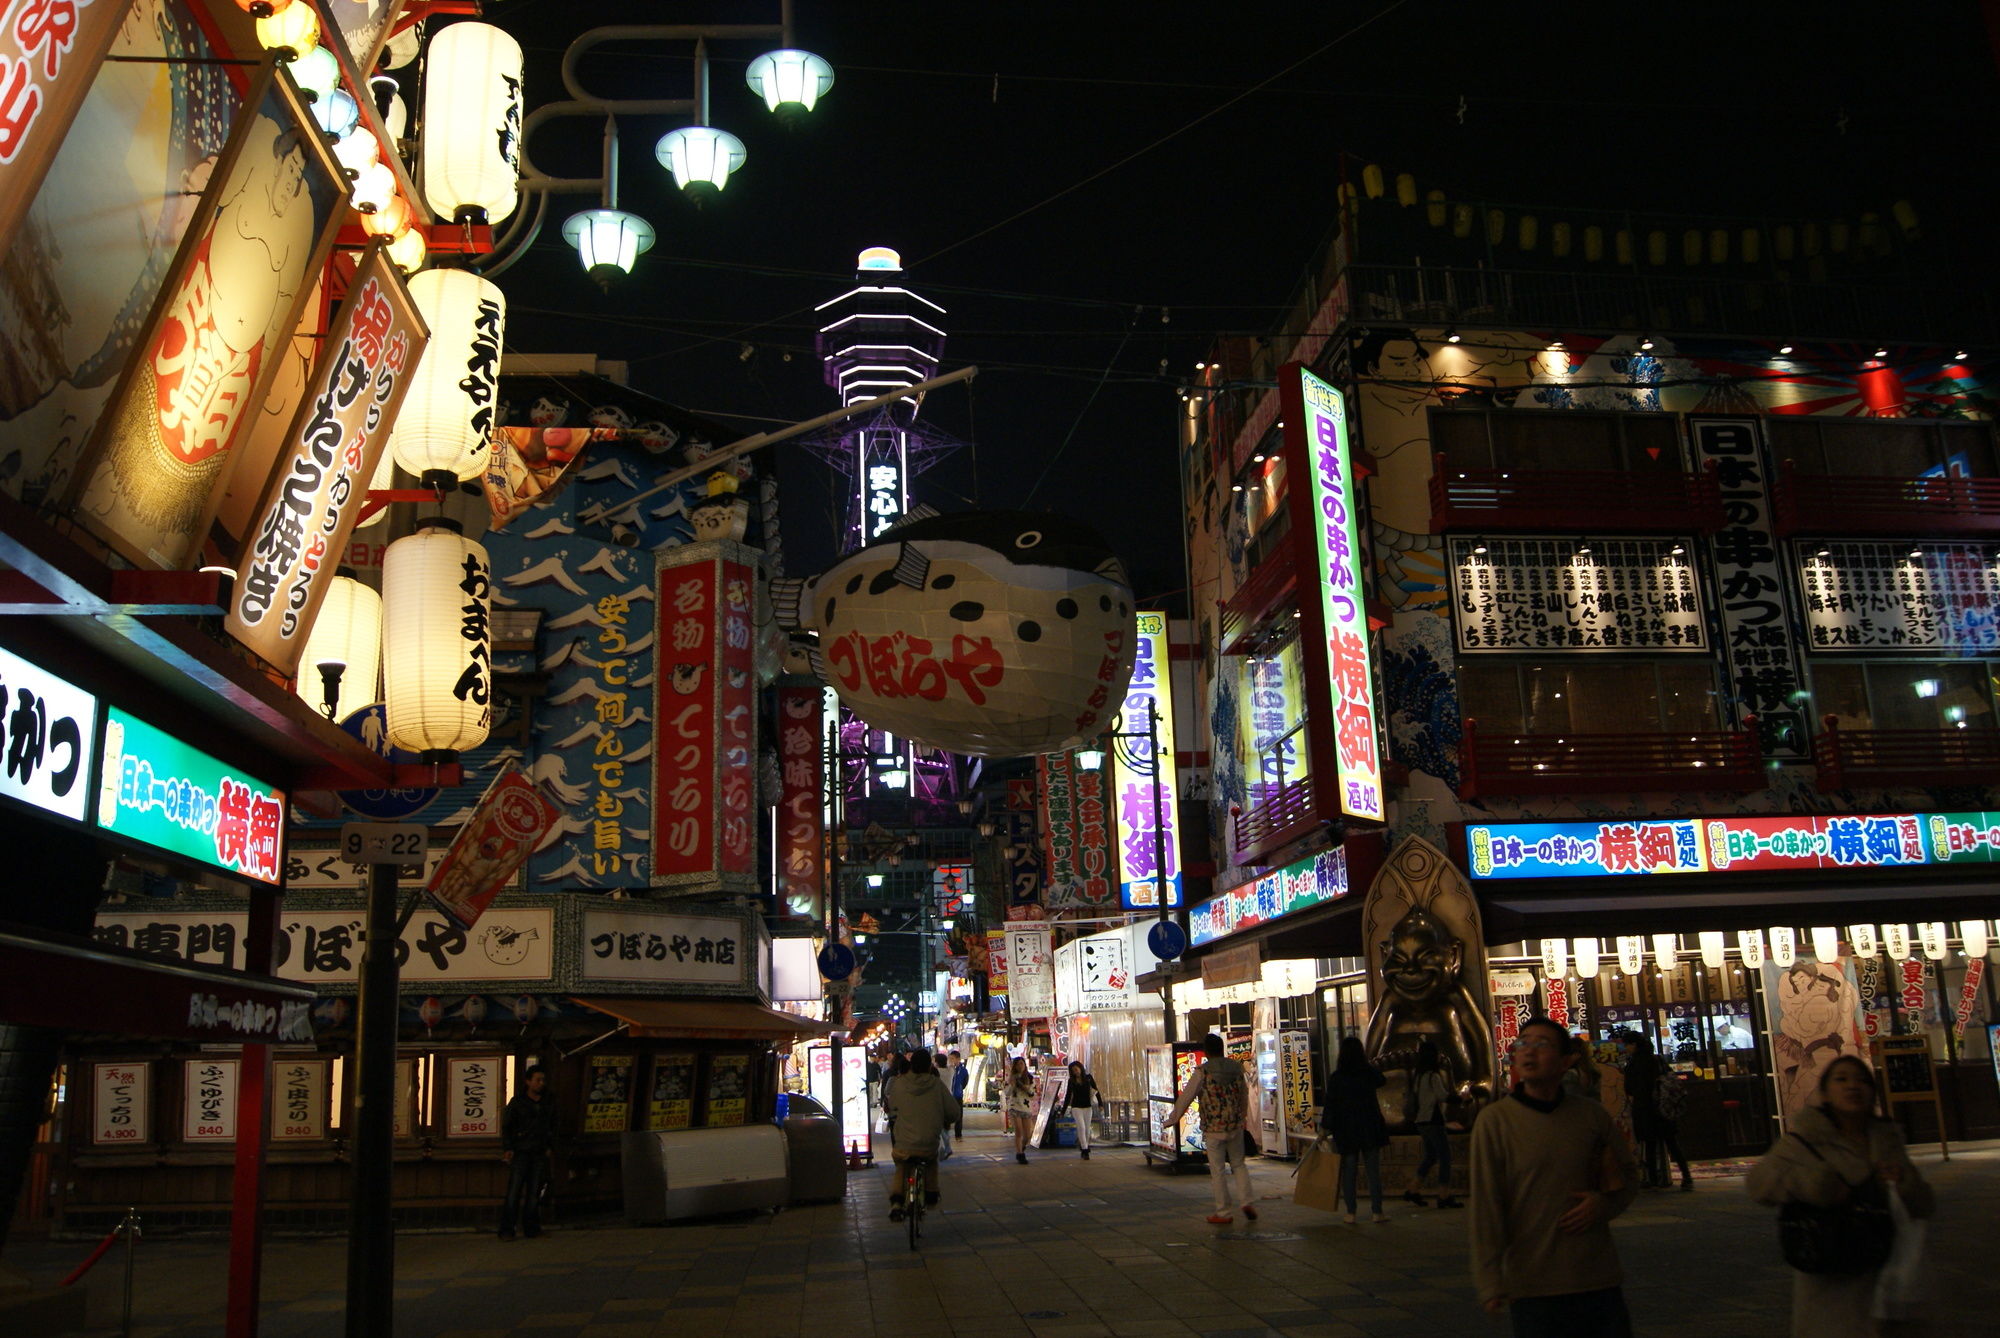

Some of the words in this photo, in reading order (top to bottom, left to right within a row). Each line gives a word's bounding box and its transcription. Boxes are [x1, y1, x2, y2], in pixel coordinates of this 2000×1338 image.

[1304, 375, 1343, 421] 新世界
[237, 277, 393, 630] 揚げたこ焼き
[1316, 413, 1357, 623] 日本一の串かつ
[1701, 424, 1783, 625] 日本一の串かつ
[1461, 592, 1480, 646] もち
[1479, 592, 1499, 646] うずら玉子
[1496, 592, 1516, 646] 紅しょうが
[1512, 592, 1531, 646] にんにく
[1530, 592, 1549, 646] 玉ねぎ
[1546, 592, 1566, 646] 山芋
[1563, 592, 1583, 646] しし唐
[1581, 592, 1602, 646] れんこん
[1597, 592, 1617, 646] 銀杏
[1614, 592, 1633, 646] 白ねぎ
[1631, 592, 1650, 646] さつま芋
[1731, 625, 1789, 649] 大阪
[1807, 593, 1829, 644] 海老
[1825, 593, 1845, 644] キス
[1840, 593, 1860, 644] 貝柱
[1854, 593, 1875, 644] サーモン
[1870, 593, 1890, 644] たこ
[1885, 593, 1906, 644] いか
[1916, 593, 1936, 645] ホルモン
[828, 629, 1005, 706] づぼらや
[1734, 648, 1791, 667] 新世界
[1125, 637, 1160, 777] 日本一の串かつ
[1330, 626, 1376, 775] 横綱
[1736, 666, 1806, 758] 横綱
[594, 594, 631, 876] 安うて何んでも旨い
[669, 703, 703, 857] てっちり
[722, 705, 750, 857] てっちり
[1347, 781, 1378, 814] 酒処
[121, 756, 215, 832] 日本一の串かつ
[216, 780, 281, 879] 横綱
[1122, 782, 1176, 880] 横綱
[1711, 823, 1729, 868] 新世界
[1728, 830, 1828, 858] 日本一の串かつ
[1829, 818, 1902, 864] 横綱
[1900, 819, 1922, 861] 酒処
[1932, 818, 1949, 860] 新世界
[1315, 851, 1339, 900] 横綱
[1474, 829, 1490, 875] 新世界
[1492, 837, 1597, 866] 日本一の串かつ
[1599, 825, 1677, 871] 横綱
[1675, 825, 1700, 868] 酒処
[591, 931, 735, 965] づぼらや本店
[1546, 978, 1570, 1029] お座敷
[105, 1068, 136, 1085] 天然
[815, 1053, 861, 1073] 串つ
[111, 1085, 132, 1125] てっちり
[197, 1125, 224, 1136] 840
[284, 1125, 312, 1136] 840
[461, 1122, 487, 1133] 850
